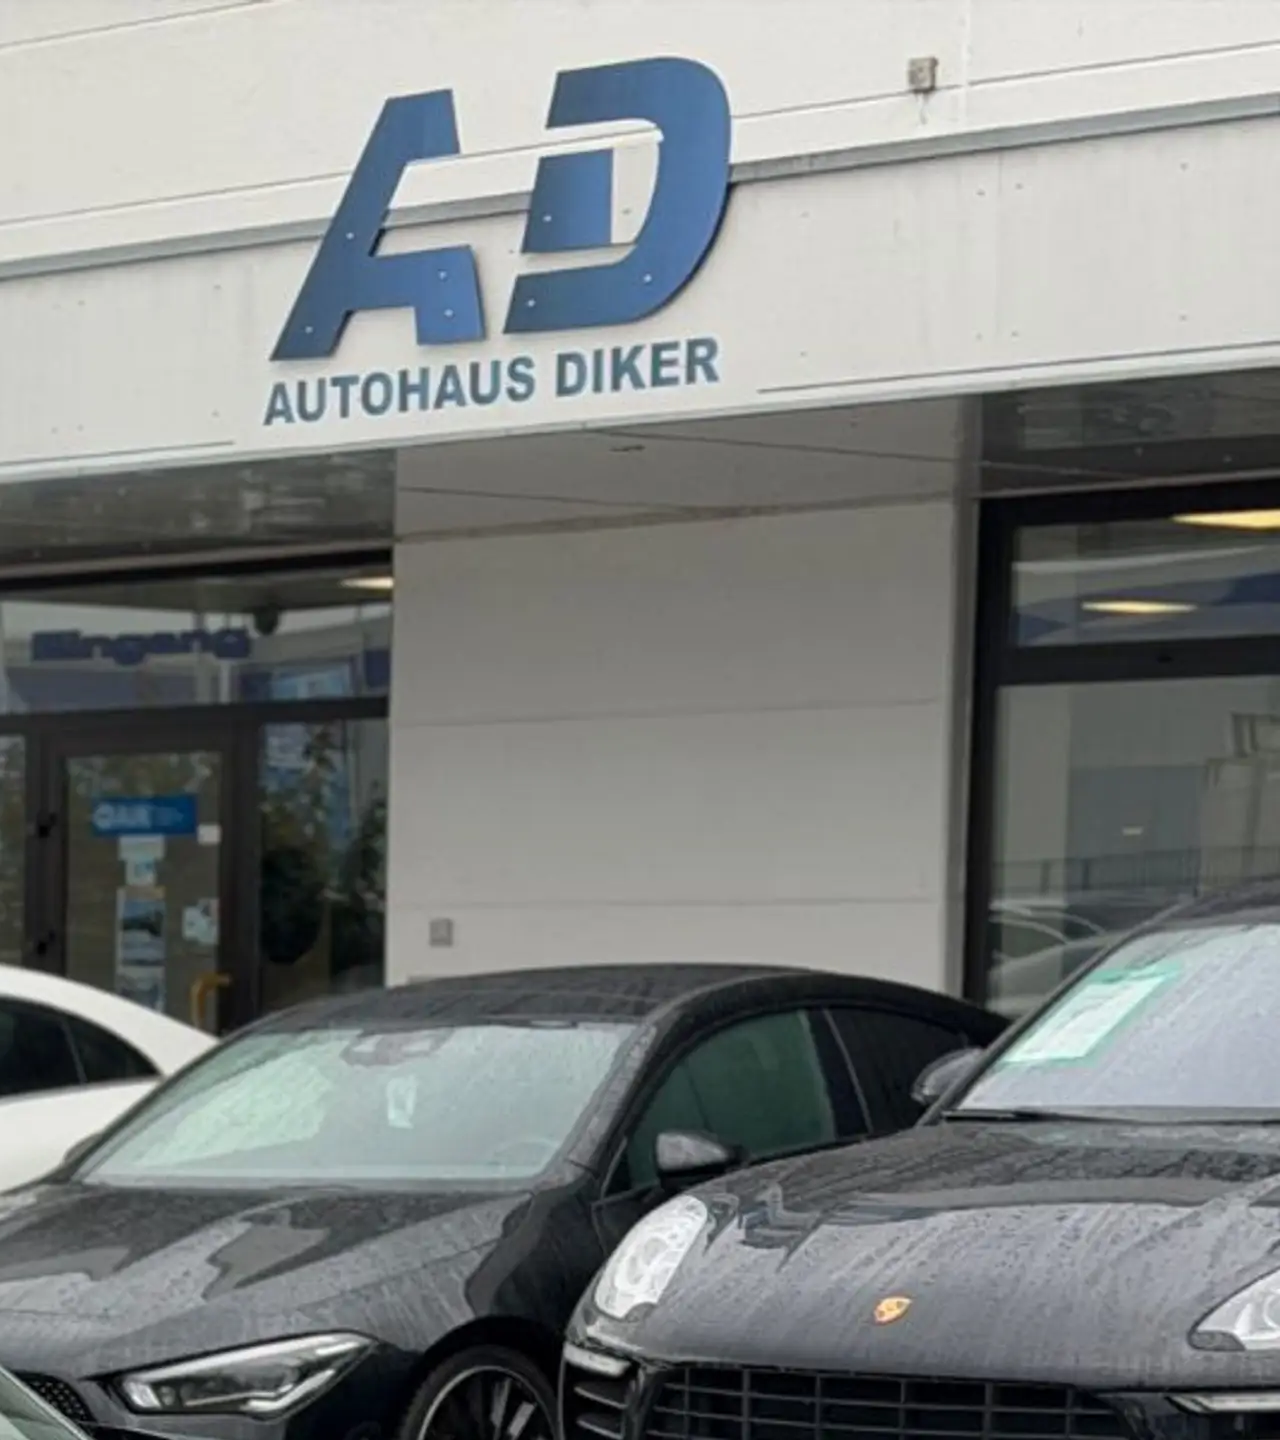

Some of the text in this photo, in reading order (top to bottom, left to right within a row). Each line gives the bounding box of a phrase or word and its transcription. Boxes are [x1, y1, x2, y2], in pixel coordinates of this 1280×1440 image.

[270, 56, 731, 361] AD
[263, 336, 720, 426] AUTOHAUS DIKER
